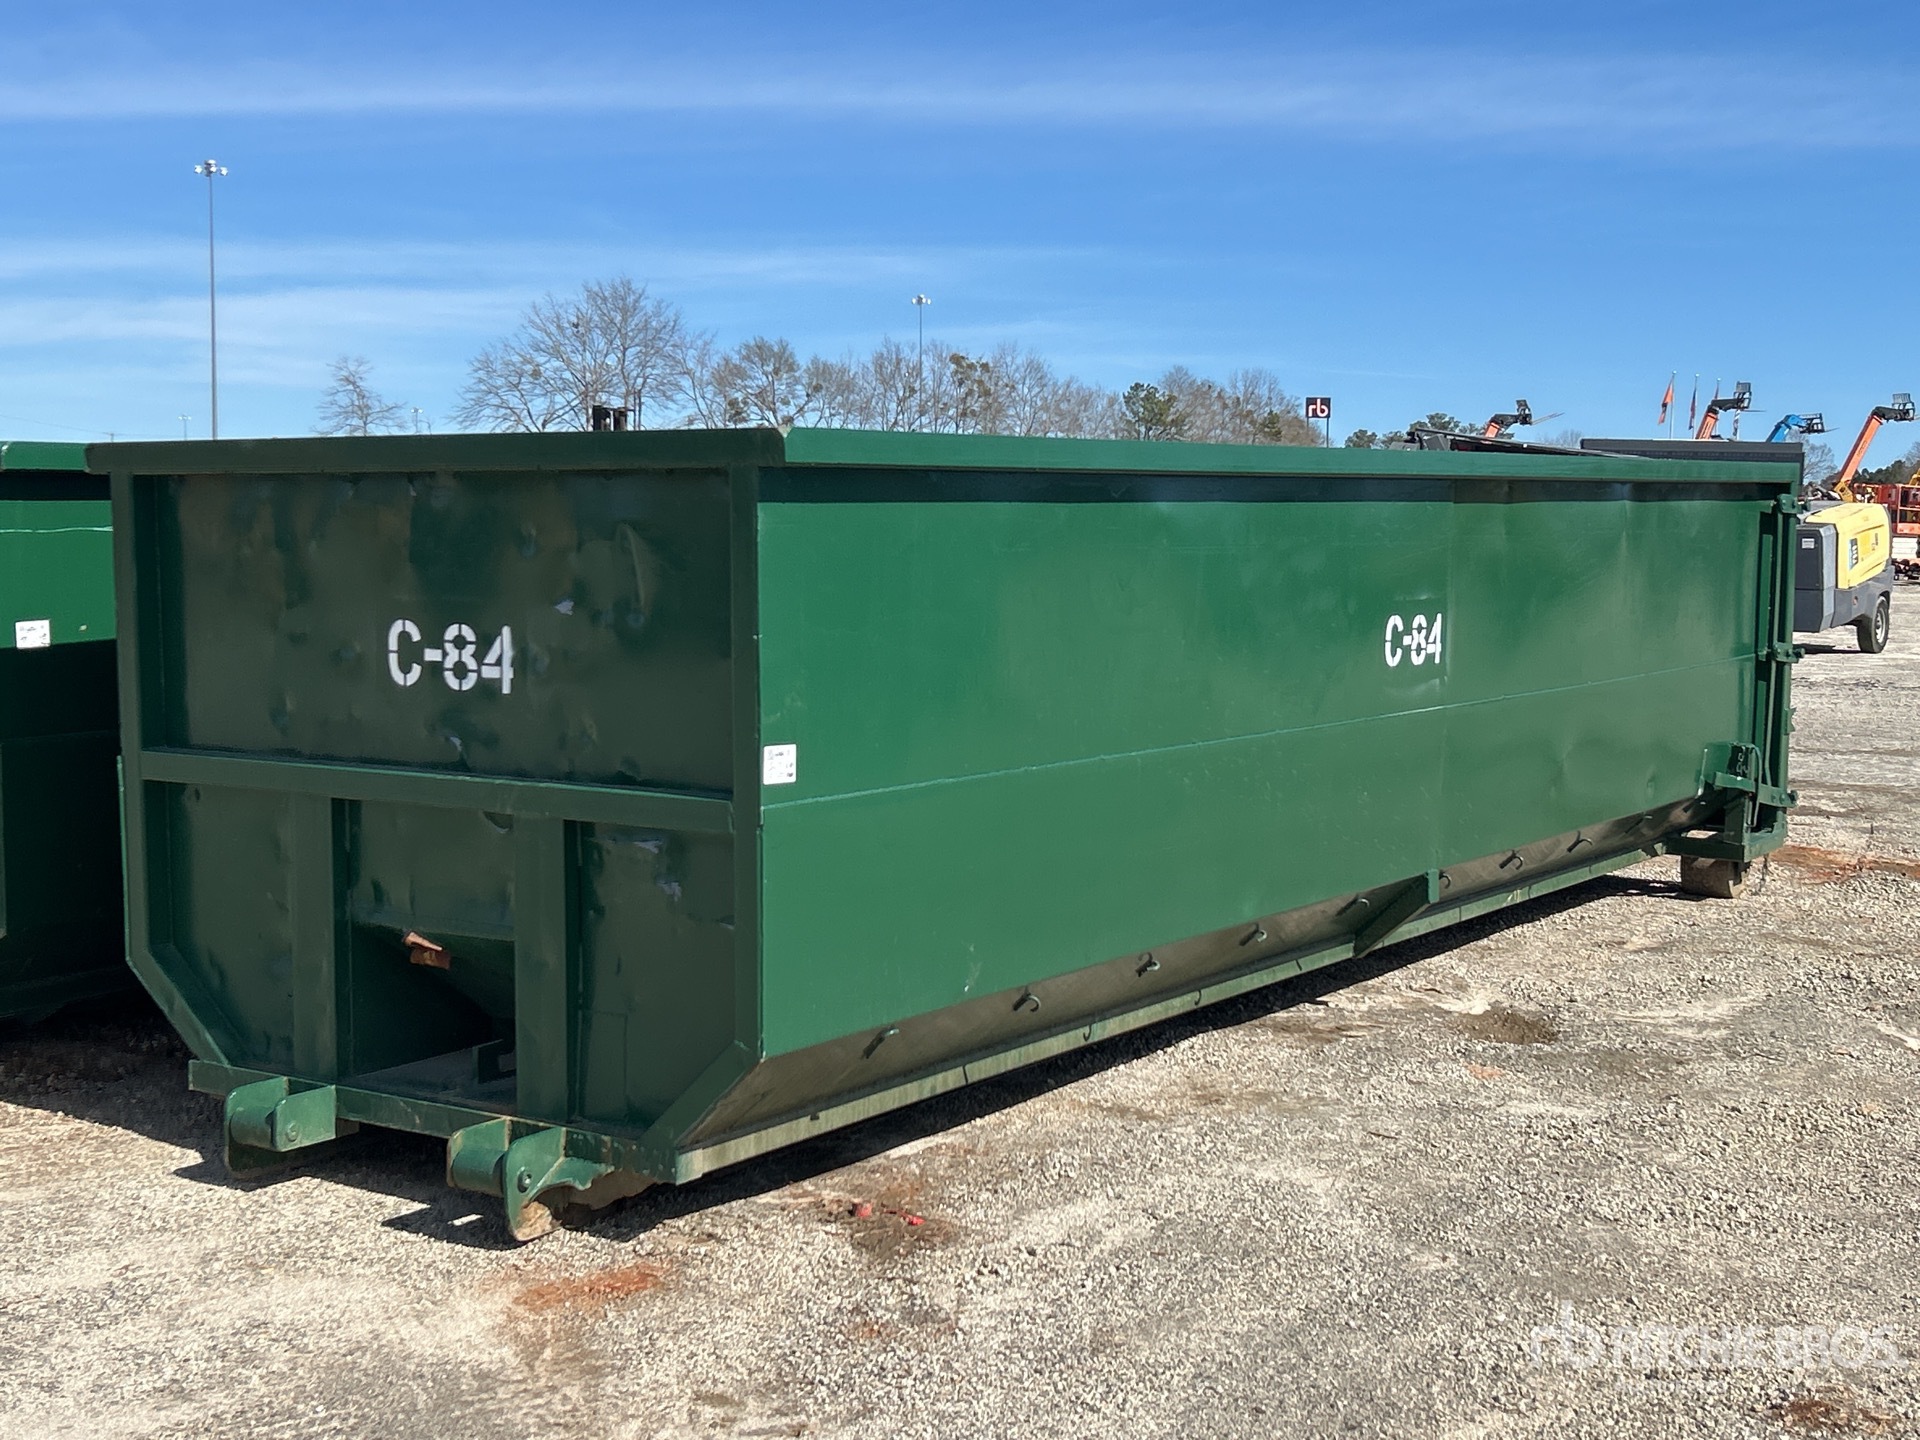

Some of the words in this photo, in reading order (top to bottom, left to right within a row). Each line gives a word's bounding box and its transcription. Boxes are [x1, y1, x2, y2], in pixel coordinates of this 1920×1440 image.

[1308, 398, 1328, 417] rb
[388, 619, 514, 694] C-84
[1385, 613, 1442, 667] C-84
